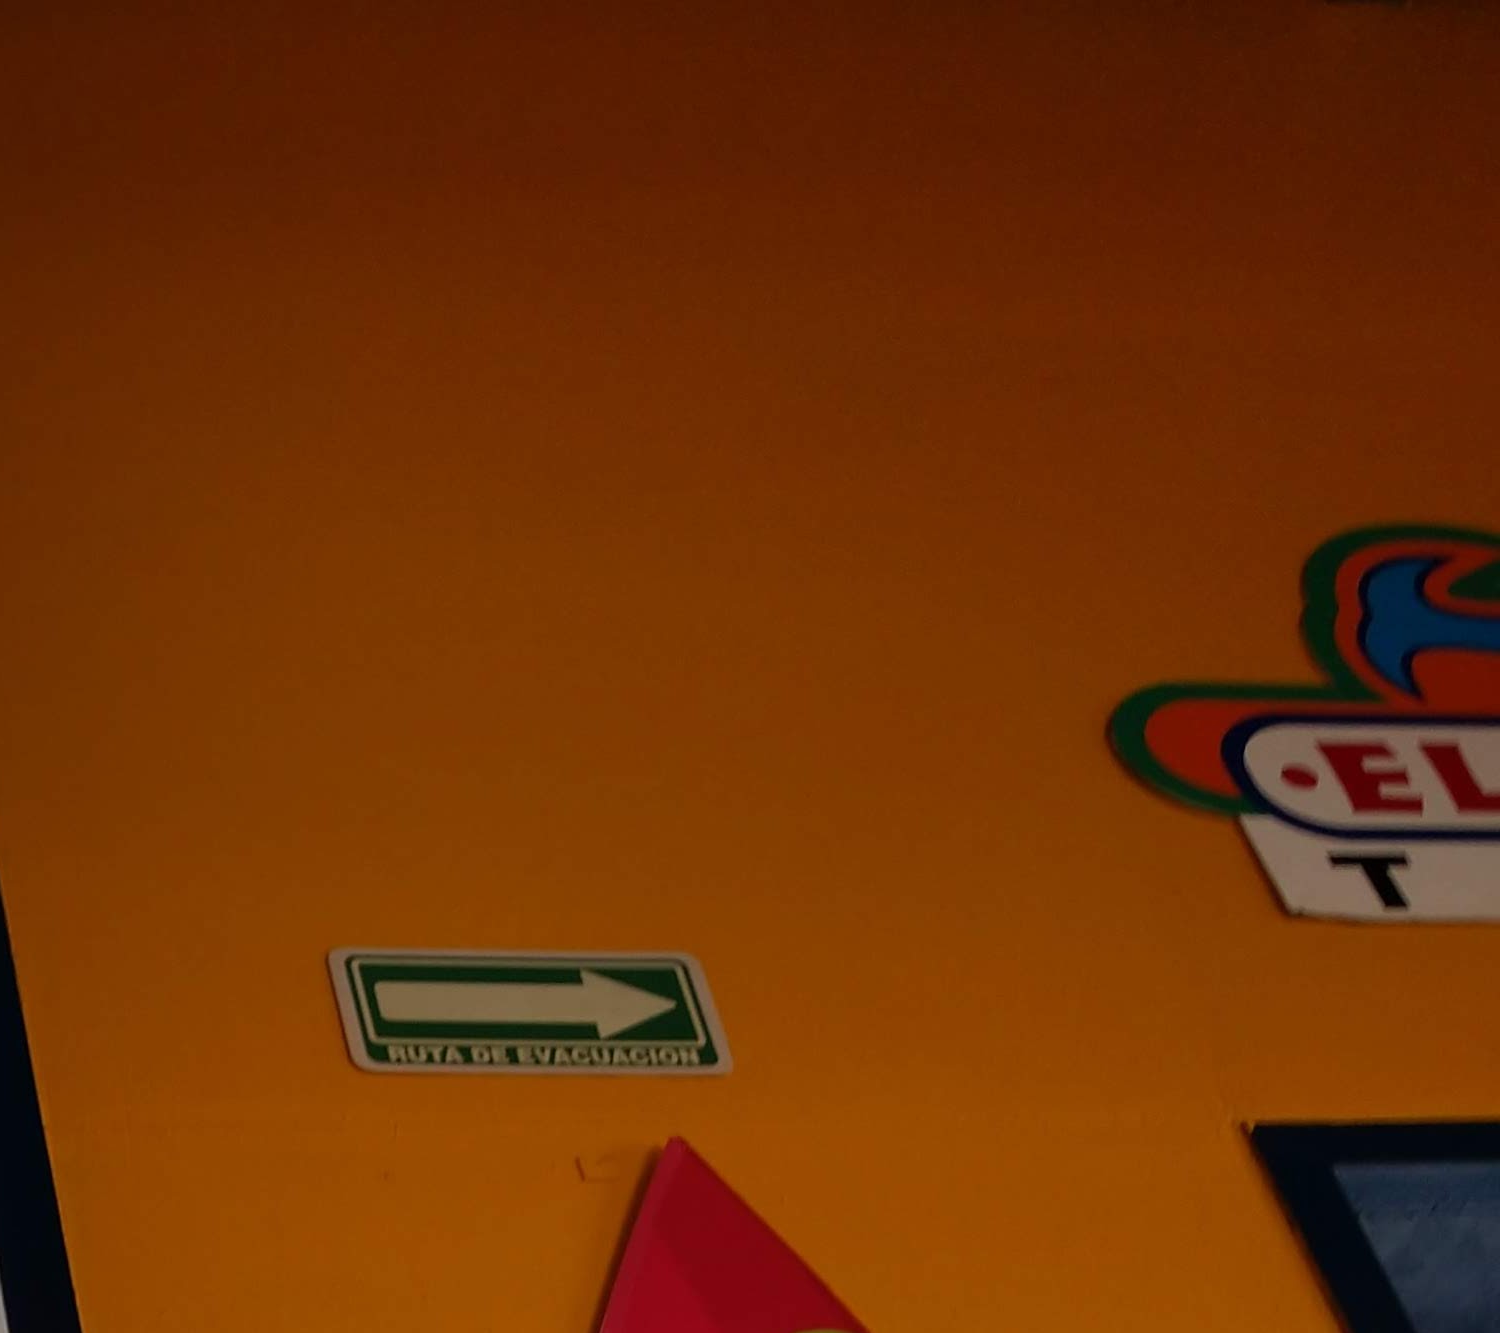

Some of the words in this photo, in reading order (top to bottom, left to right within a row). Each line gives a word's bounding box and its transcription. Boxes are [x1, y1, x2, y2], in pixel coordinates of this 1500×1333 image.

[1314, 737, 1500, 818] EL
[386, 1044, 463, 1065] RUTA
[471, 1045, 510, 1066] DE
[517, 1045, 701, 1067] EVACUACION
